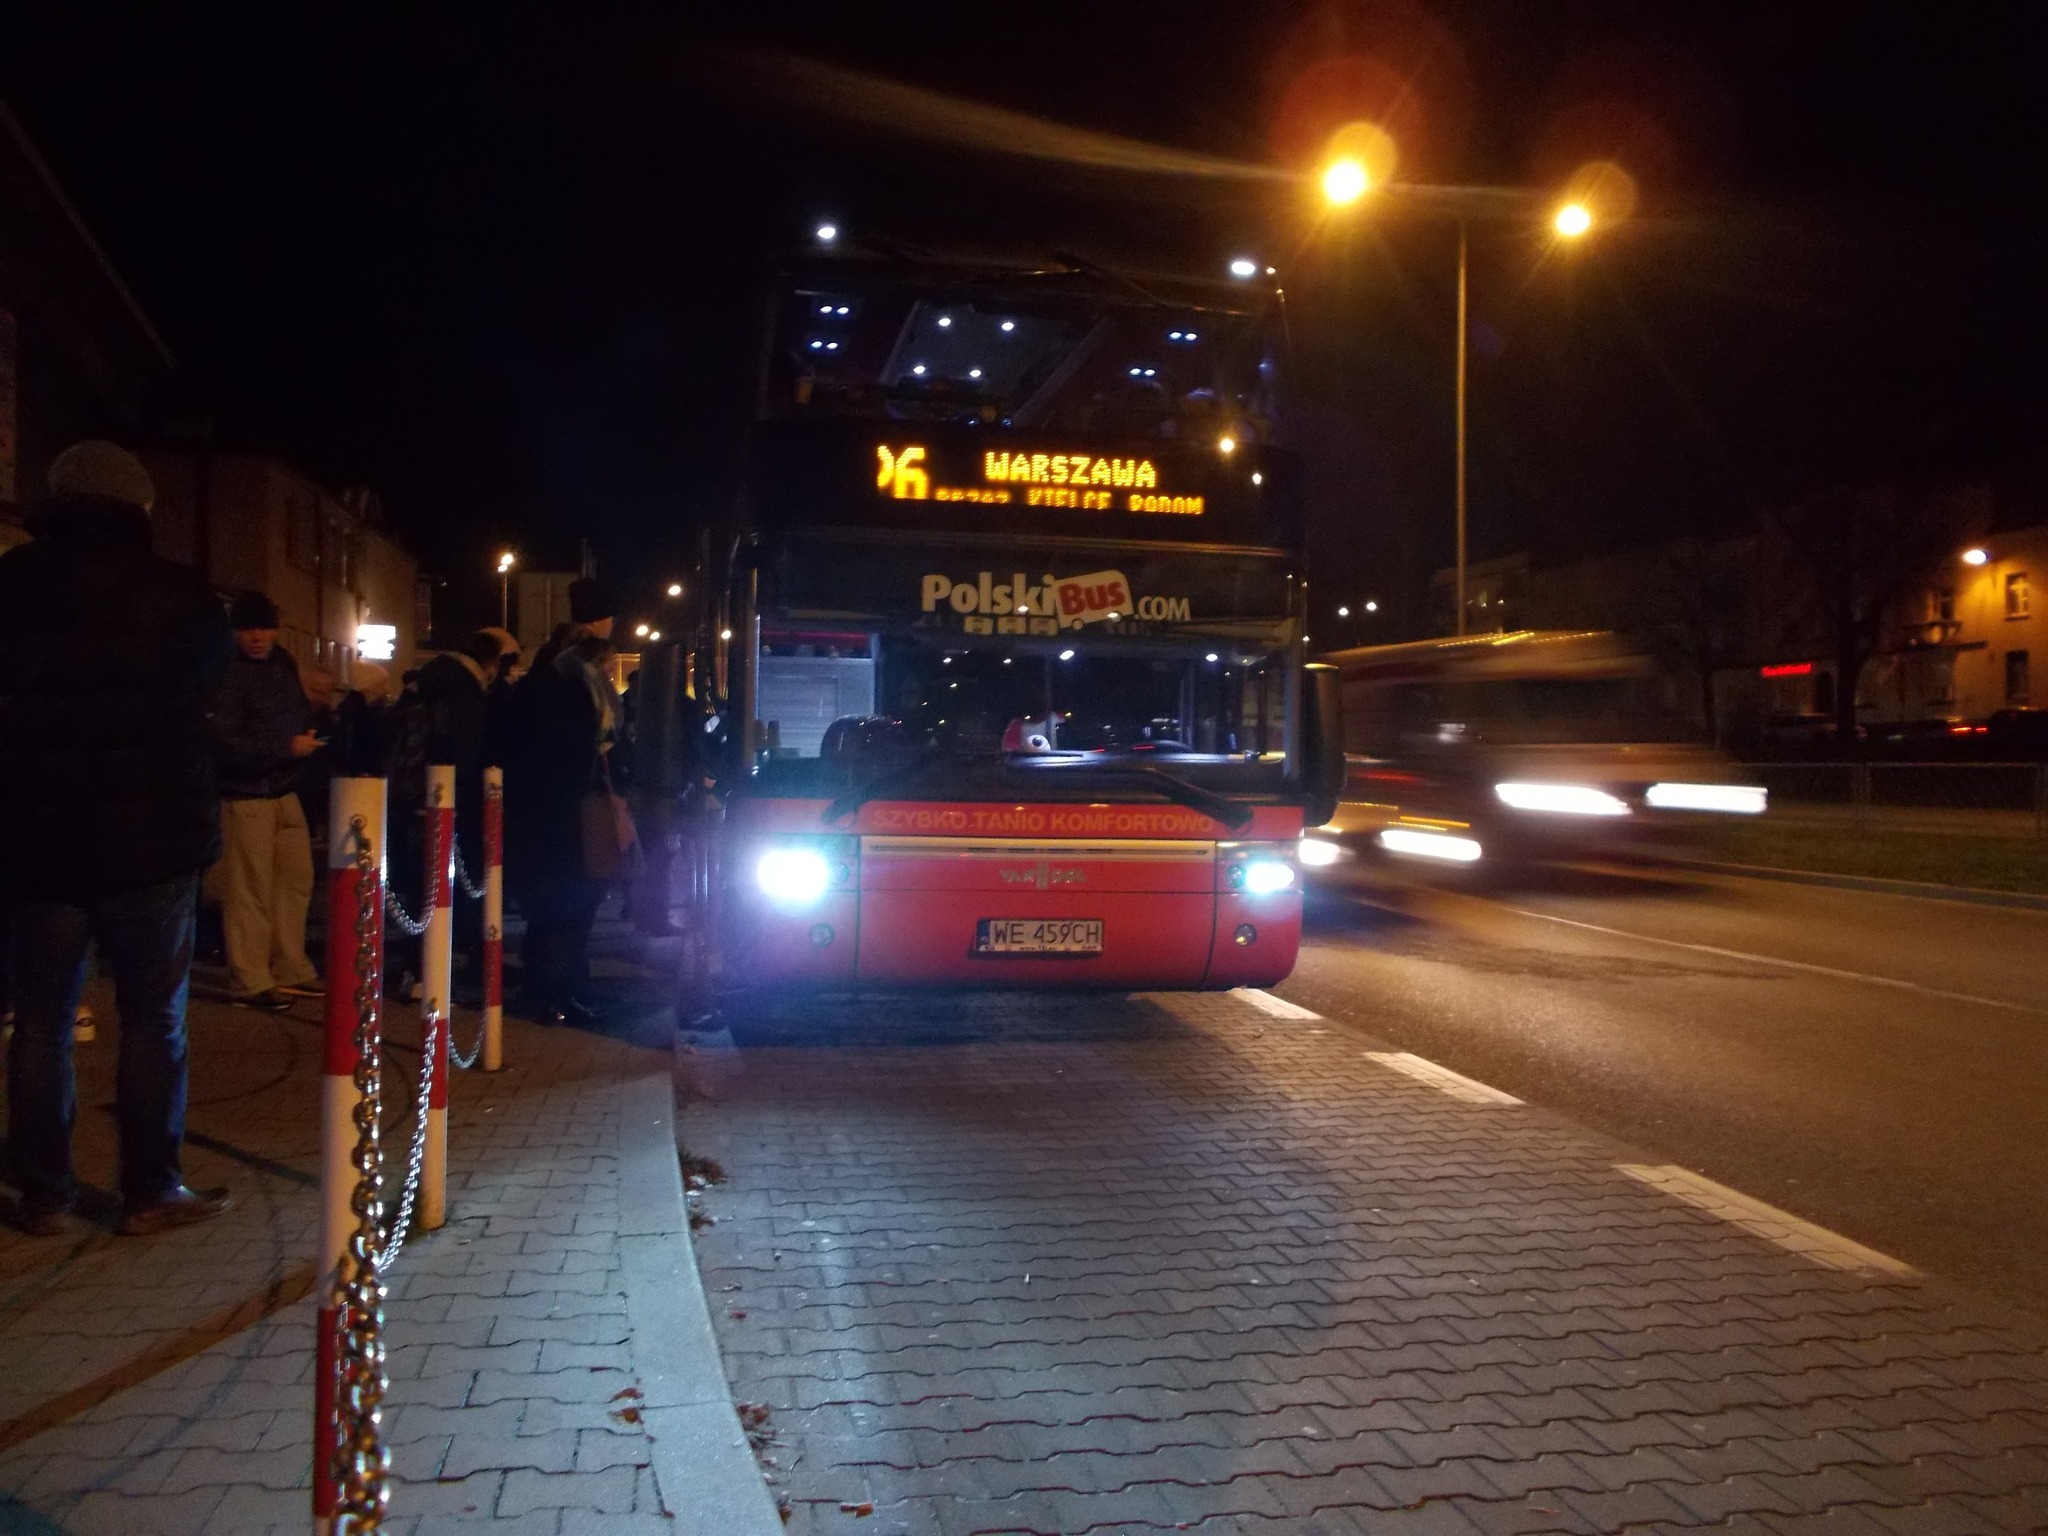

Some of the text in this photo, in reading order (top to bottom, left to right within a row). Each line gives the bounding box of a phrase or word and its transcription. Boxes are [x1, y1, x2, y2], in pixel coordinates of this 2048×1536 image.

[985, 451, 1157, 488] WARSZAWA
[873, 809, 1214, 833] SZYBKO TANIO KOMFORTOWO
[994, 922, 1100, 944] WE 459CH
